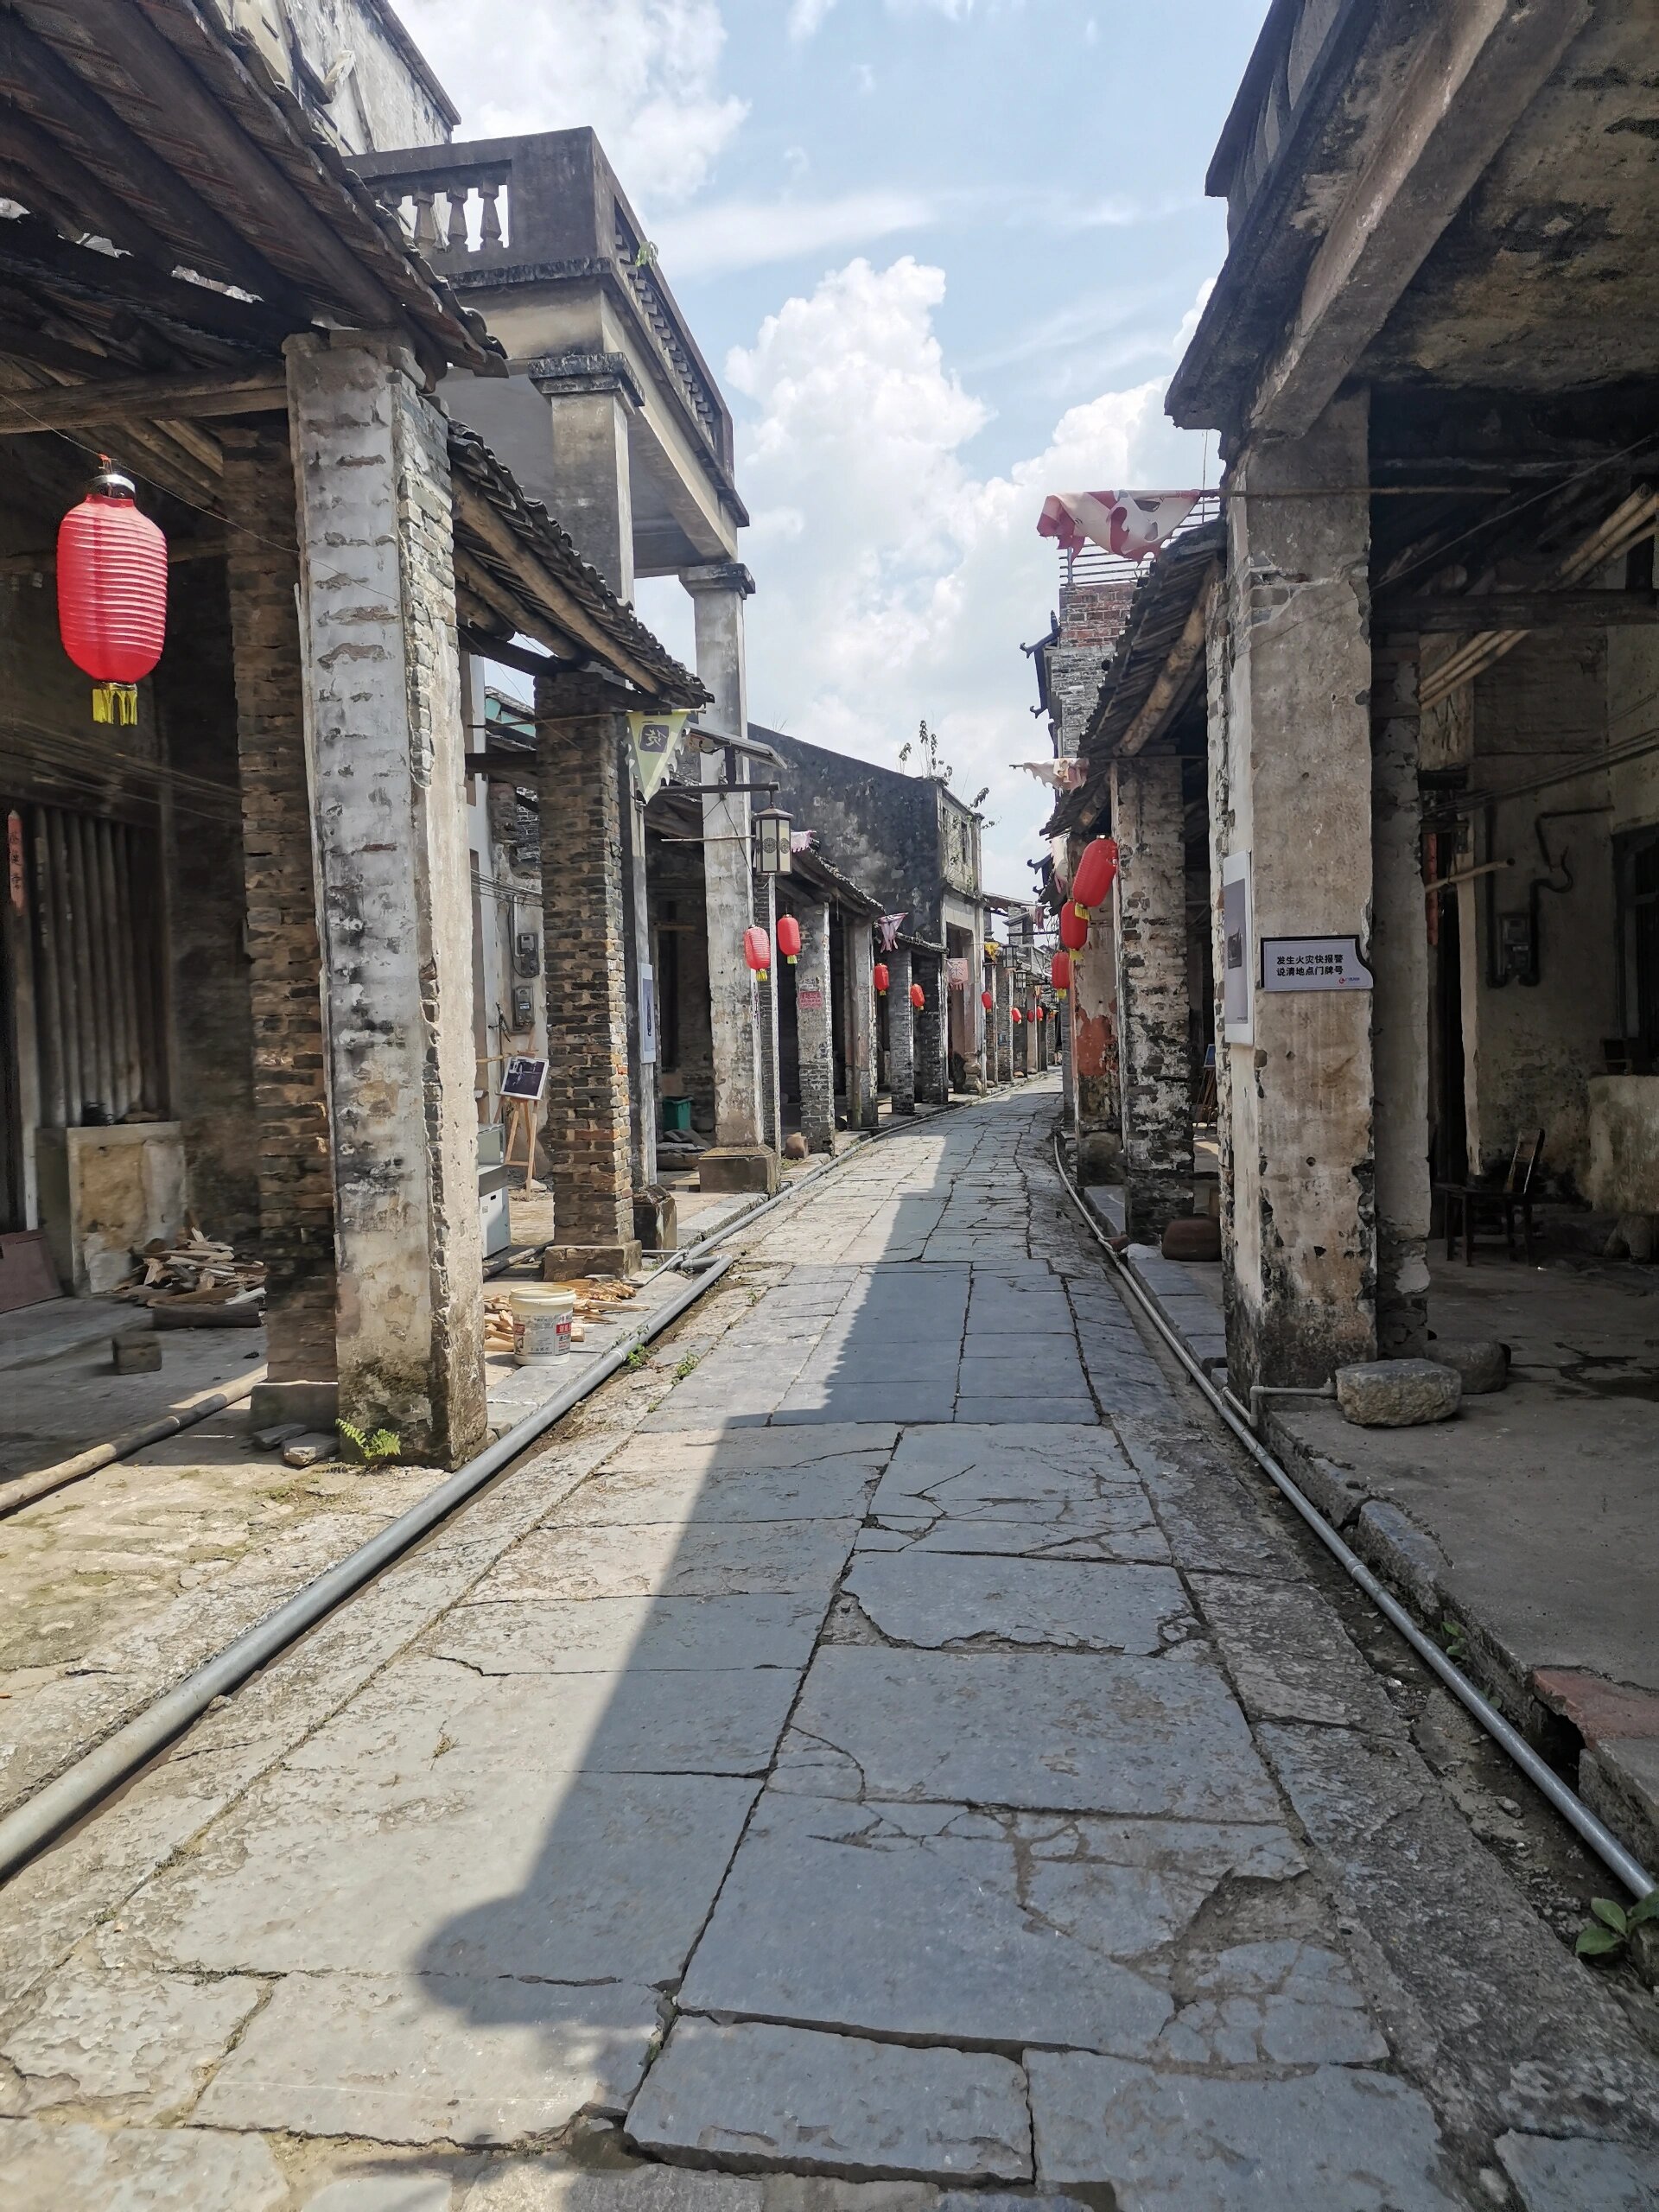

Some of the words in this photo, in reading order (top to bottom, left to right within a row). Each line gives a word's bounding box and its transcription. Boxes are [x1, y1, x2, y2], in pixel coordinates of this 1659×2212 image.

[1277, 954, 1344, 965] 发生火灾快报警
[1277, 965, 1344, 976] 说清地点门牌号
